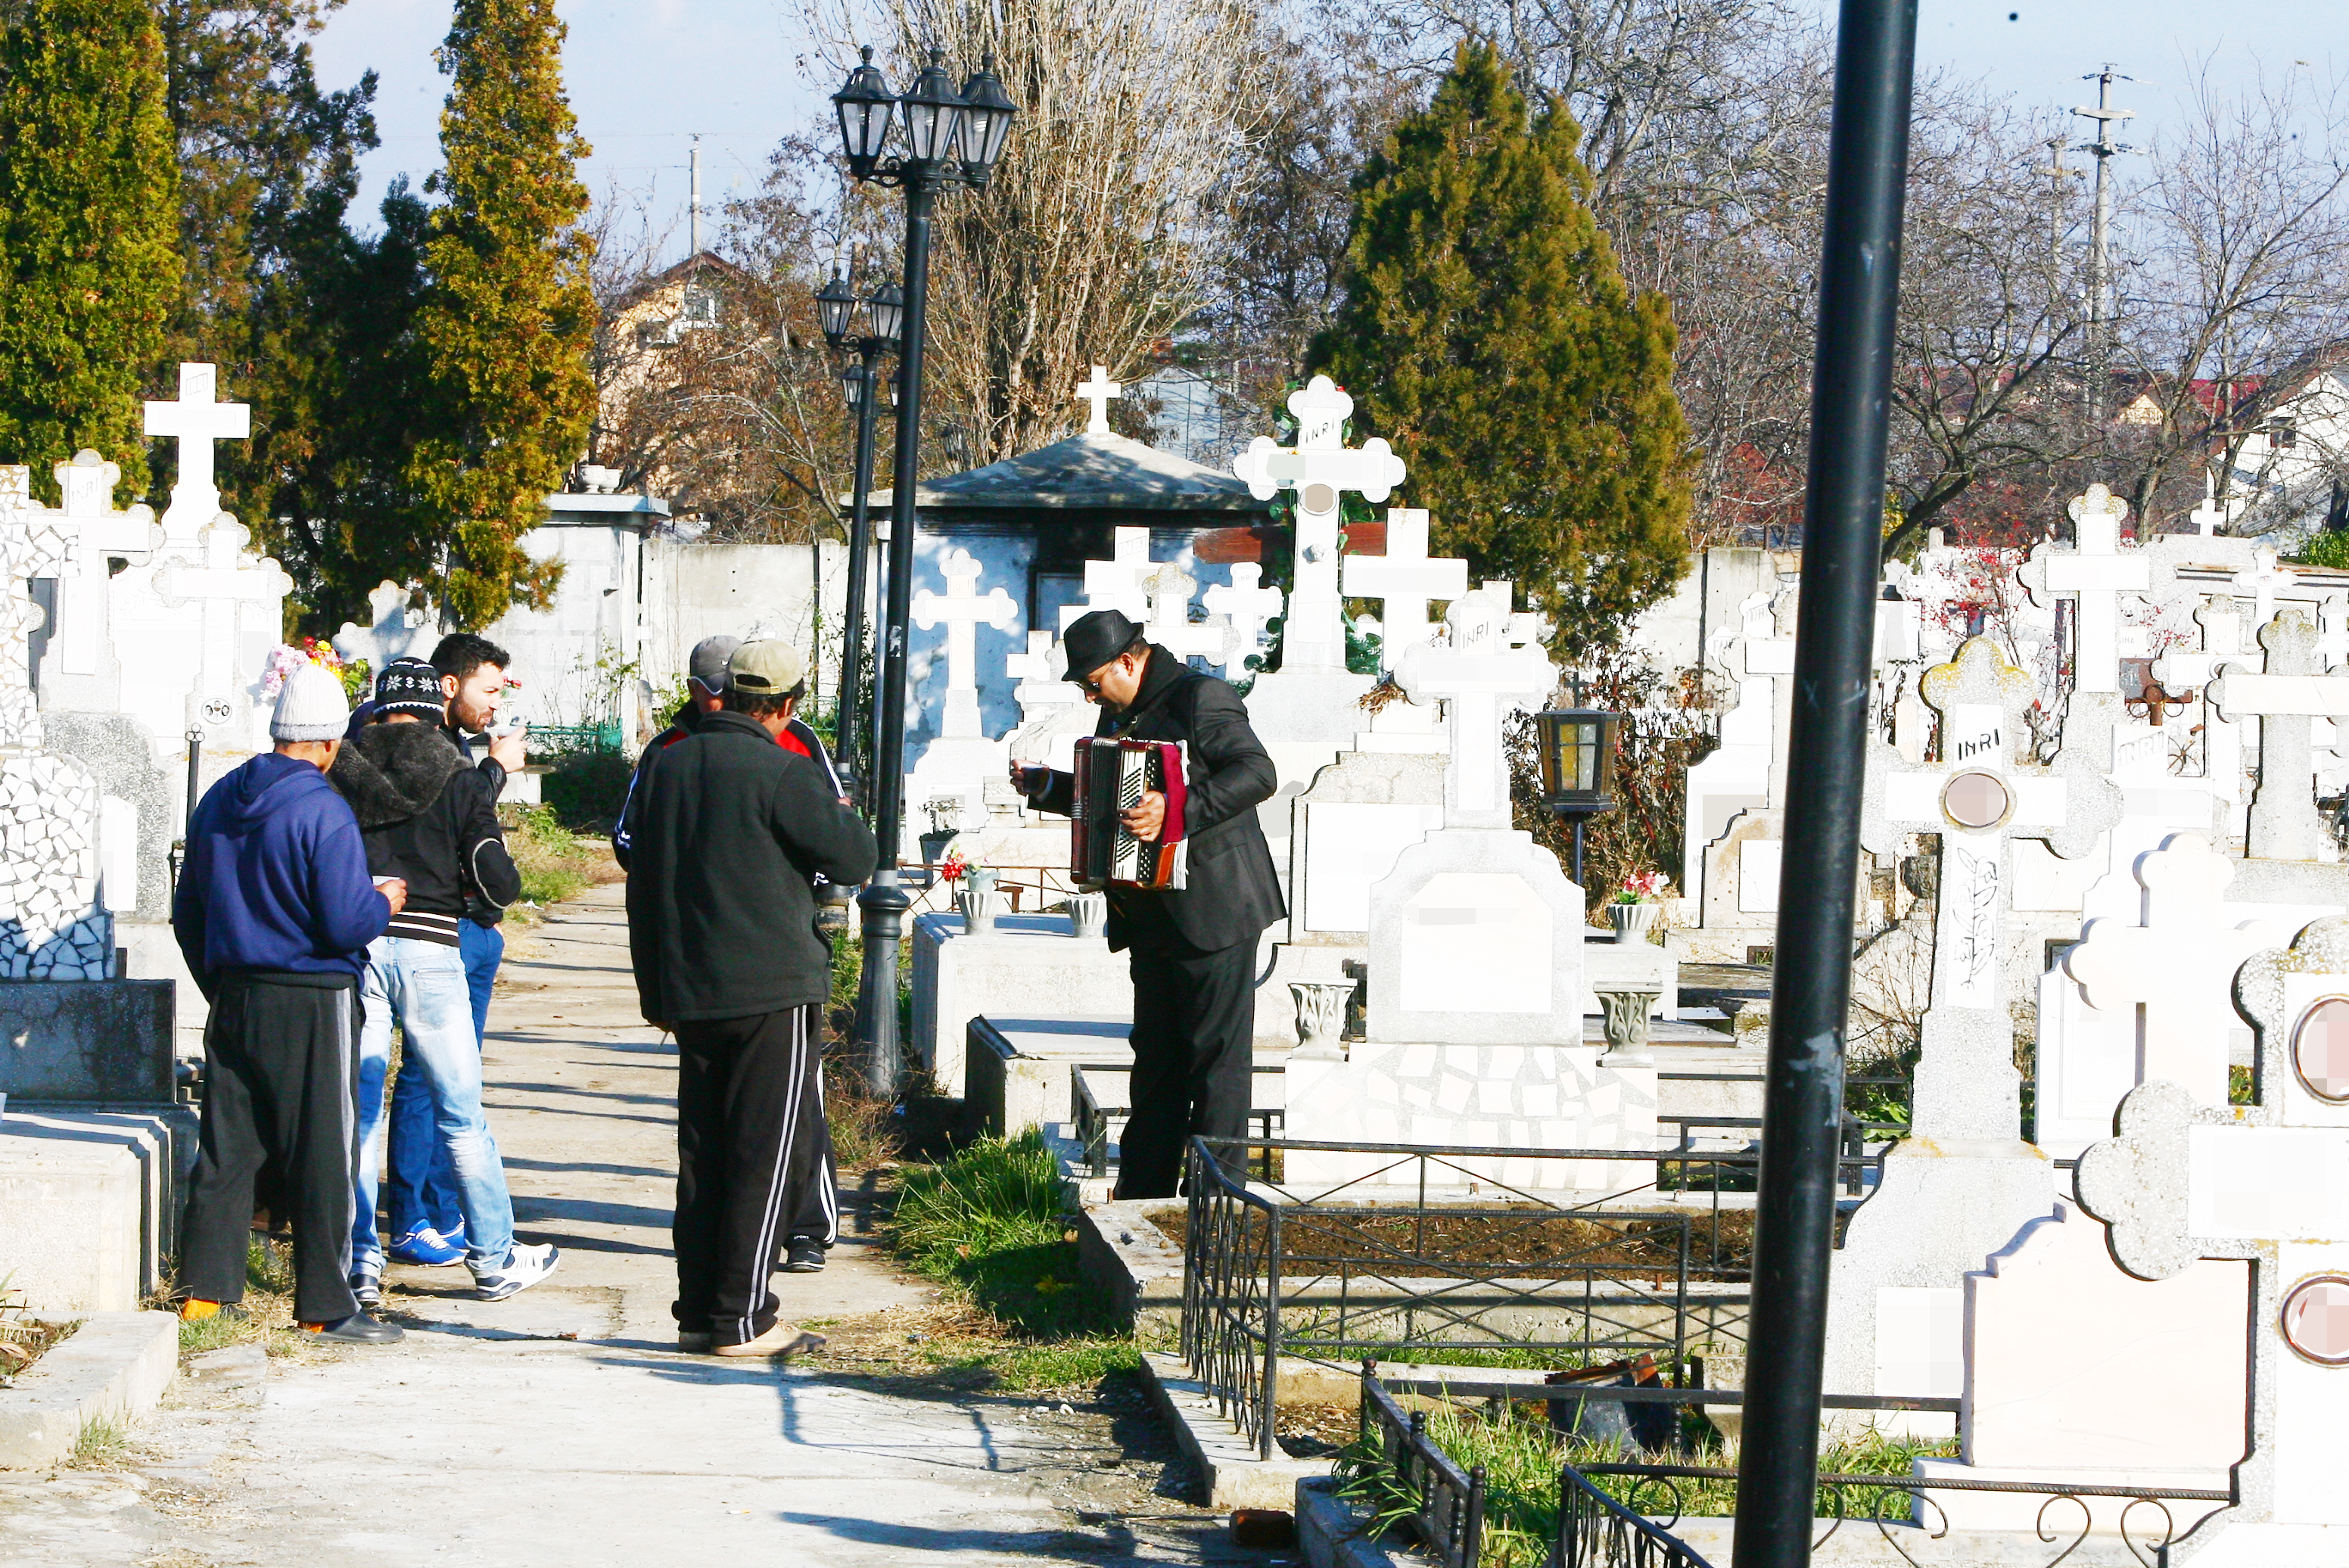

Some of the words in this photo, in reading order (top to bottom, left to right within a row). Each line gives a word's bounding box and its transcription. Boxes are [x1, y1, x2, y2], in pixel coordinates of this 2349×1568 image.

[1305, 418, 1334, 444] INRI
[71, 477, 98, 505] INRI
[1117, 535, 1147, 559] INRI
[1238, 574, 1253, 583] INRI
[1462, 621, 1489, 649] INRI
[1958, 728, 2000, 761] INRI
[2118, 730, 2164, 766] INRI
